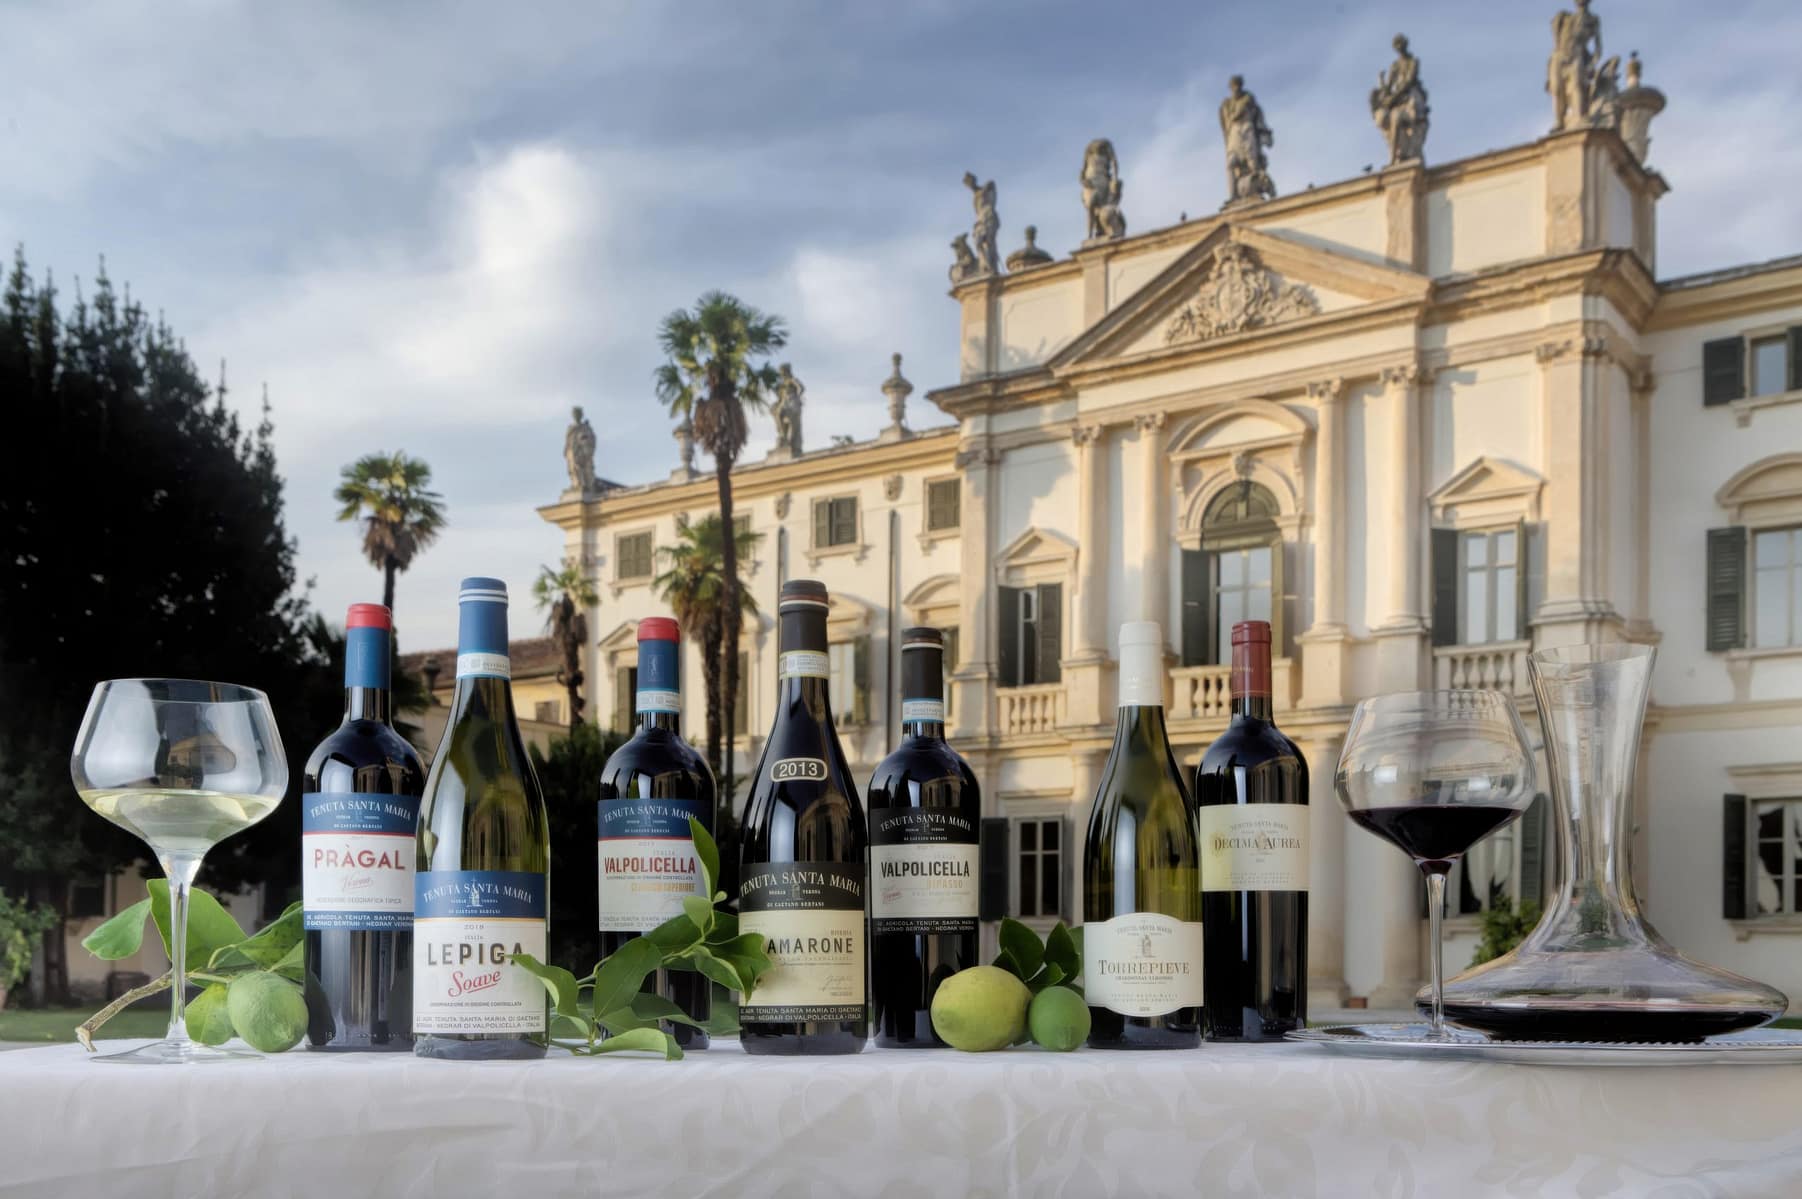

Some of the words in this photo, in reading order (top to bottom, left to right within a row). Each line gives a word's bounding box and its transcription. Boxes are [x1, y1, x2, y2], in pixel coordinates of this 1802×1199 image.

[779, 761, 818, 777] 2013
[311, 801, 345, 818] TENUTA
[348, 800, 381, 811] SANTA
[384, 803, 412, 821] MARIA
[604, 807, 634, 822] TENUTA
[637, 805, 668, 817] SANTA
[880, 815, 914, 831] TENUTA
[916, 814, 946, 825] SANTA
[948, 816, 971, 831] MARIA
[1214, 838, 1259, 850] DECIMA
[1263, 837, 1301, 849] AUREA
[314, 844, 405, 870] PRÀGAL
[604, 857, 696, 874] VALPOLICELLA
[880, 861, 970, 878] VALPOLICELLA
[740, 873, 777, 897] TENUTA
[782, 871, 825, 885] SANTA
[829, 874, 860, 897] MARIA
[423, 884, 460, 903] TENUTA
[463, 883, 500, 895] SANTA
[502, 885, 533, 904] MARIA
[767, 937, 853, 954] AMARONE
[1098, 959, 1190, 976] TORREPIEVE
[447, 970, 502, 997] Soave
